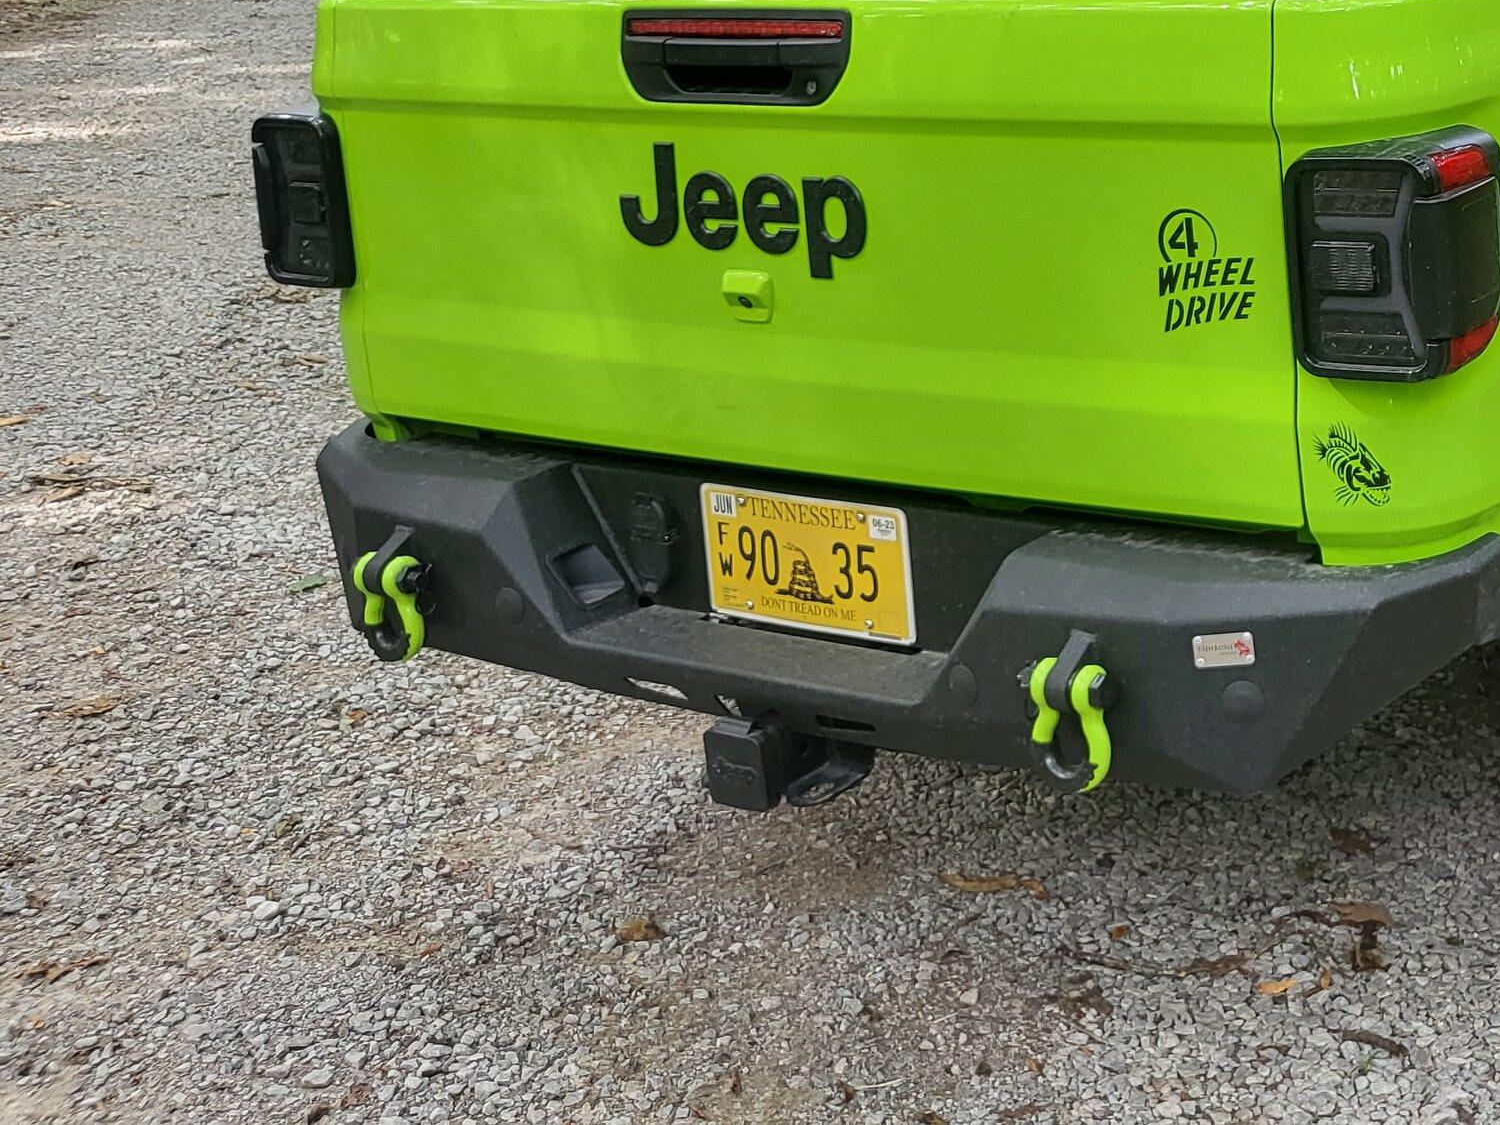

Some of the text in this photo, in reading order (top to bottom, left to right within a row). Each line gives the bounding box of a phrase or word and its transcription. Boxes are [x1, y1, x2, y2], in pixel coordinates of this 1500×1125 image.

[619, 141, 867, 279] Jeep
[1168, 217, 1199, 258] 4
[1158, 257, 1255, 298] WHEEL
[1164, 291, 1256, 332] DRIVE
[713, 494, 733, 514] JUN
[748, 496, 856, 530] TENNESSEE
[738, 525, 780, 586] 90
[832, 541, 879, 602] 35
[761, 595, 786, 611] DONT
[789, 599, 821, 617] TREAD
[823, 606, 839, 619] ON
[841, 609, 857, 622] ME
